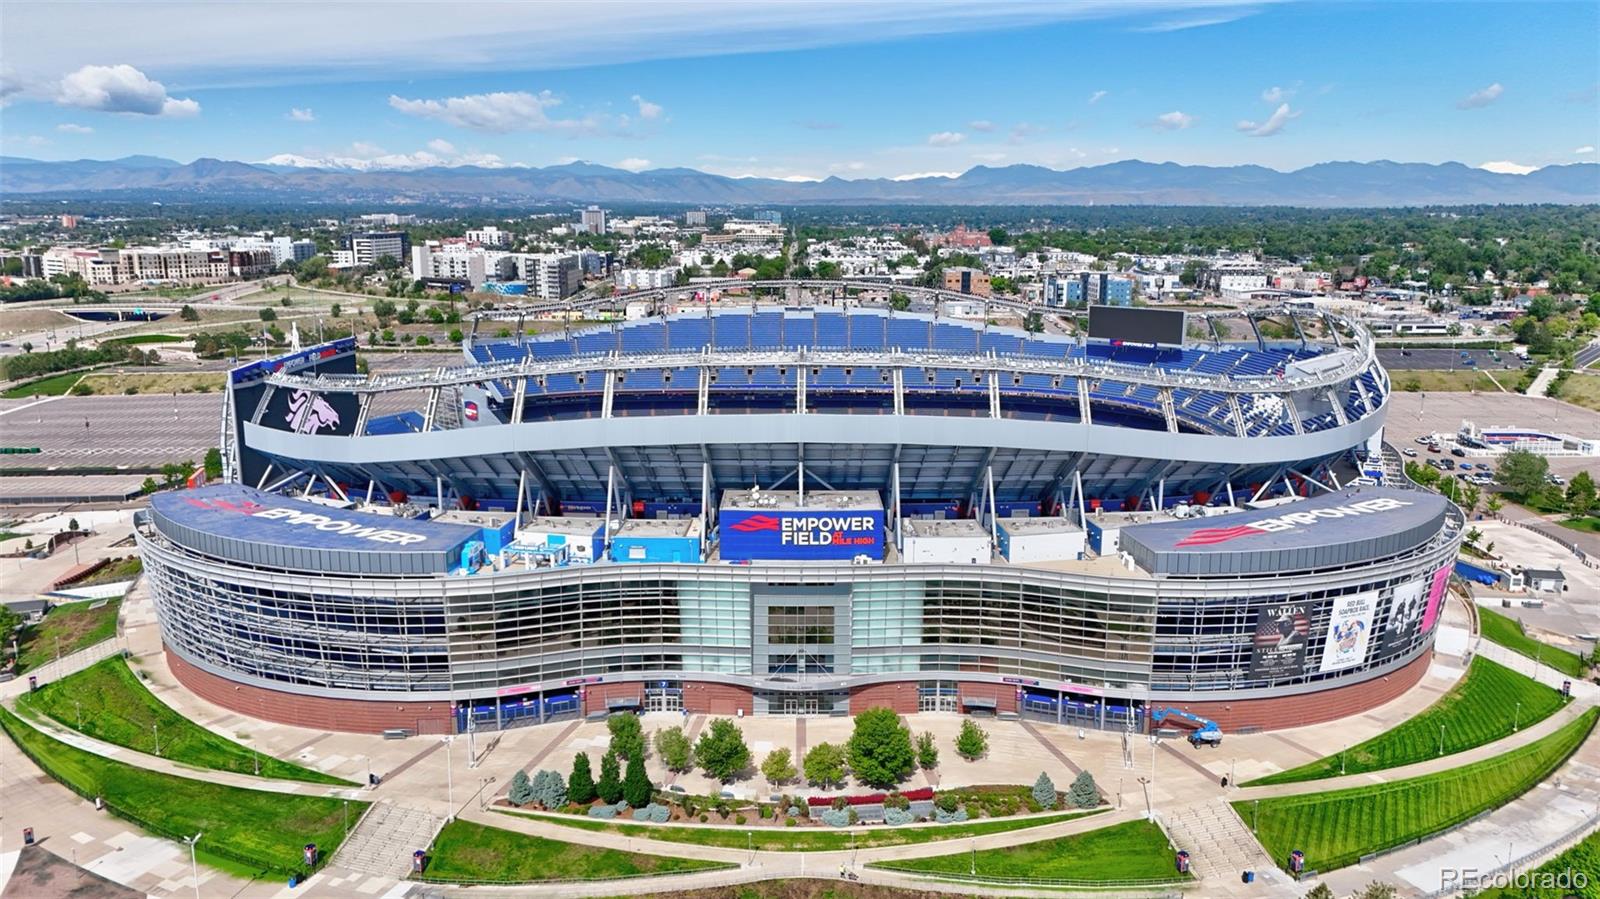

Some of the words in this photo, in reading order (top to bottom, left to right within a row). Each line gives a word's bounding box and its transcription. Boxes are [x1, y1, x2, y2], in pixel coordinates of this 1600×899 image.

[782, 518, 874, 531] EMPOWER
[1245, 498, 1413, 532] EMPOWER
[252, 508, 427, 546] EMPOWER
[782, 532, 832, 545] FIELD
